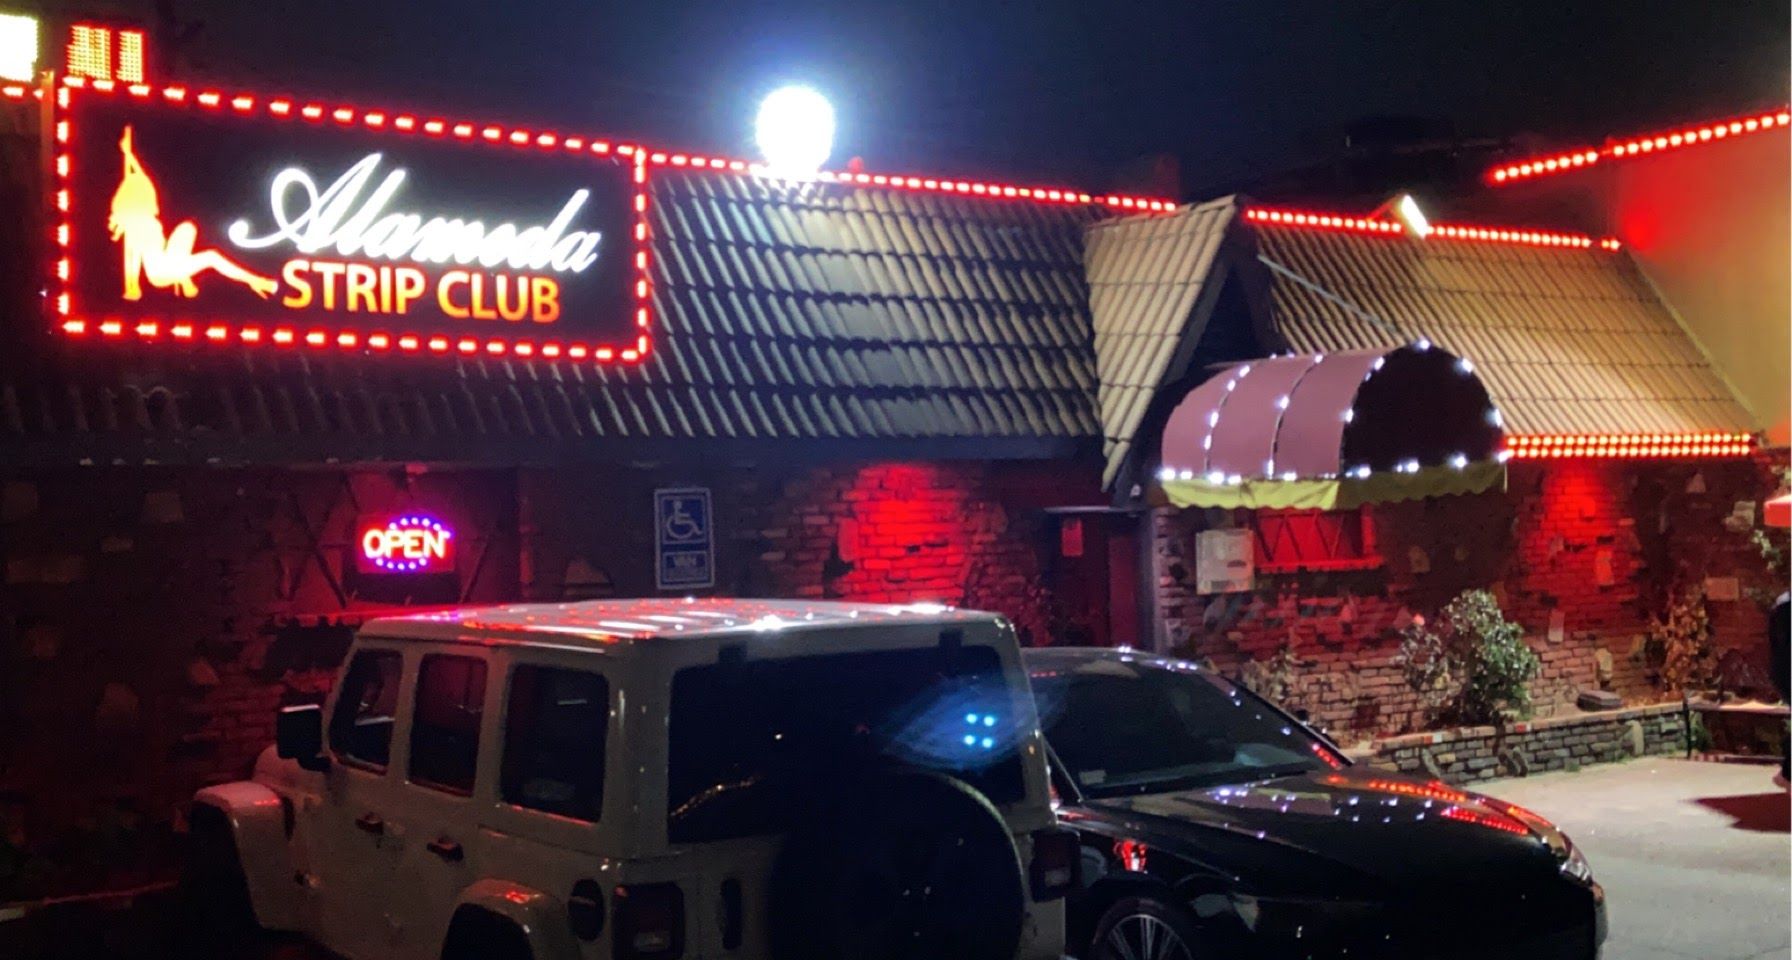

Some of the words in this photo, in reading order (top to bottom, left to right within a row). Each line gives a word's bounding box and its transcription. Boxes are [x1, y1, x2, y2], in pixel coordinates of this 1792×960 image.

[228, 152, 601, 273] Alameda
[282, 258, 426, 315] STRIP
[436, 270, 561, 323] CLUB
[362, 528, 446, 559] OPEN
